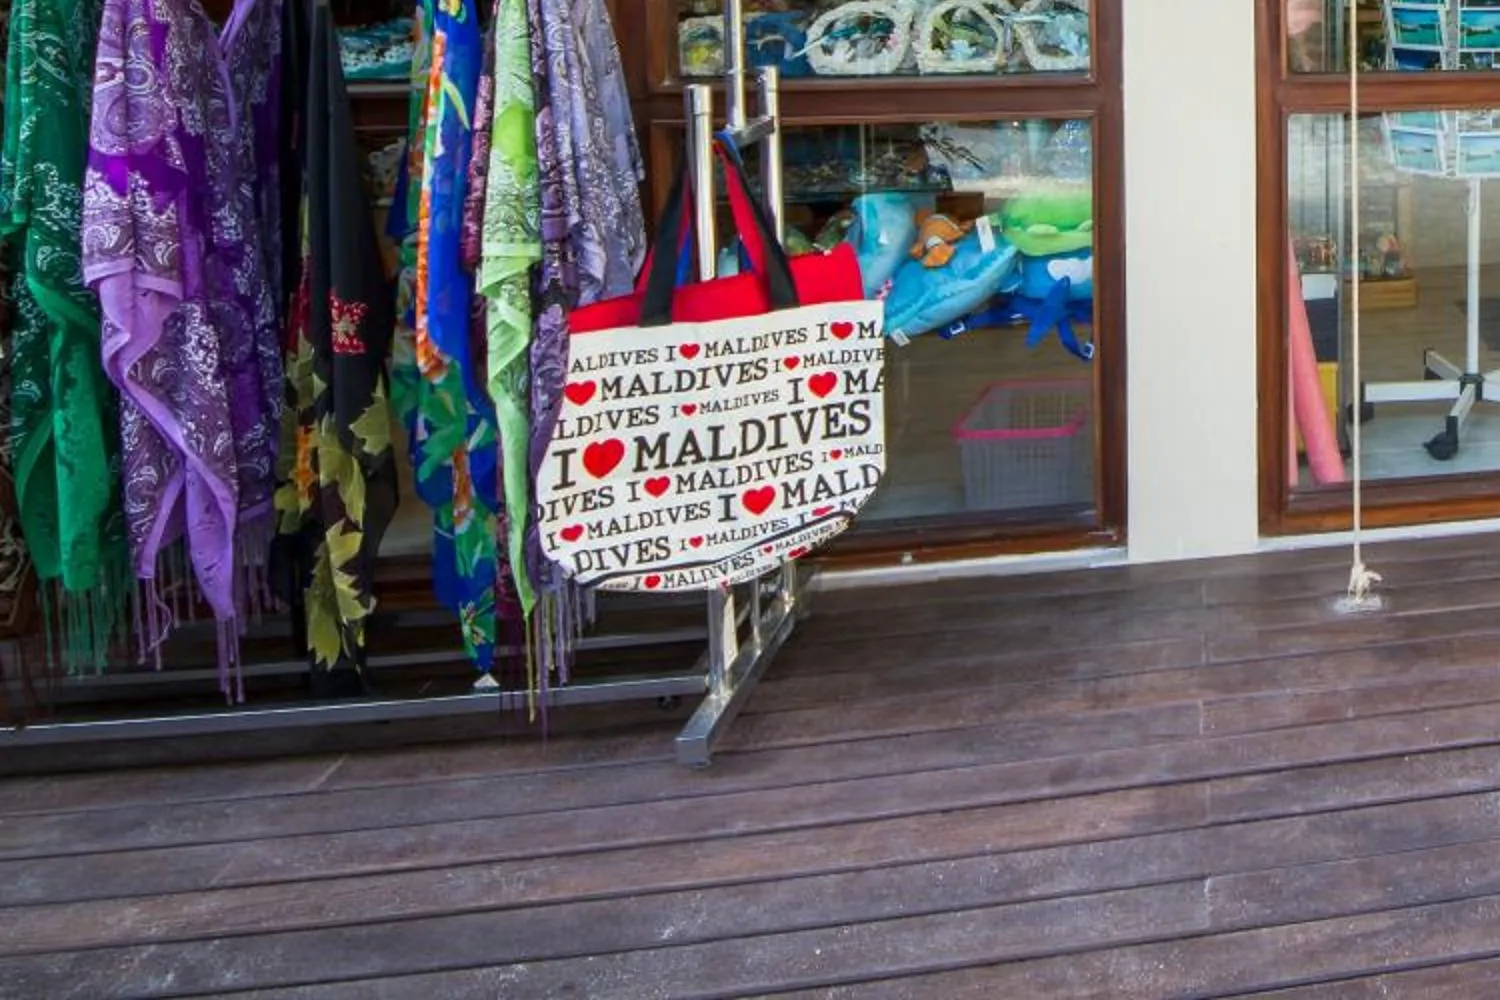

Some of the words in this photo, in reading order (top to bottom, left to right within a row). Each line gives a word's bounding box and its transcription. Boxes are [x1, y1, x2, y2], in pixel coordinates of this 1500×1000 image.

[571, 348, 659, 373] ALDIVES
[665, 345, 678, 362] I
[704, 328, 808, 358] MALDIVES
[816, 322, 829, 343] I
[856, 320, 884, 339] M
[601, 357, 769, 402] MALDIVES
[773, 359, 782, 373] I
[670, 405, 679, 418] I
[699, 389, 779, 414] MALDIVES
[787, 377, 804, 405] I
[552, 448, 577, 491] I
[632, 399, 872, 473] MALDIVES
[626, 481, 641, 503] I
[675, 451, 814, 495] MALDIVES
[821, 452, 828, 463] I
[546, 532, 561, 552] I
[586, 501, 711, 540] MALDIVES
[718, 493, 738, 523] I
[571, 536, 671, 574] DIVES
[679, 539, 688, 551] I
[706, 517, 790, 547] MALDIVES
